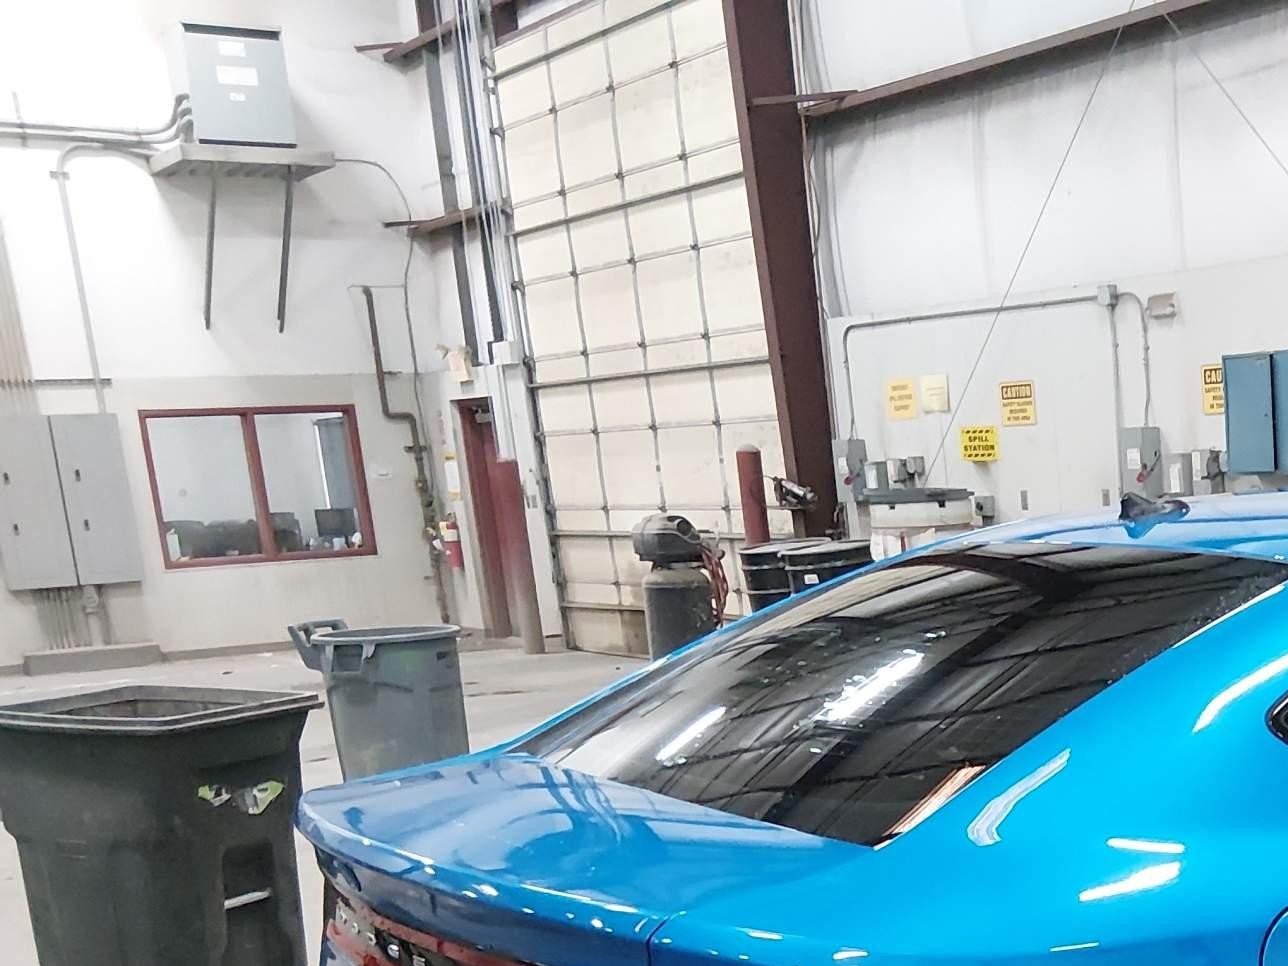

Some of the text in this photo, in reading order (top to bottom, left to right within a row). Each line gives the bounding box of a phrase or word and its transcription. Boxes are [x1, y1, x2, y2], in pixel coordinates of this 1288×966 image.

[1205, 370, 1222, 383] CAU
[1002, 386, 1031, 399] CAUTION
[968, 435, 989, 443] SPILL
[964, 444, 995, 452] STATION
